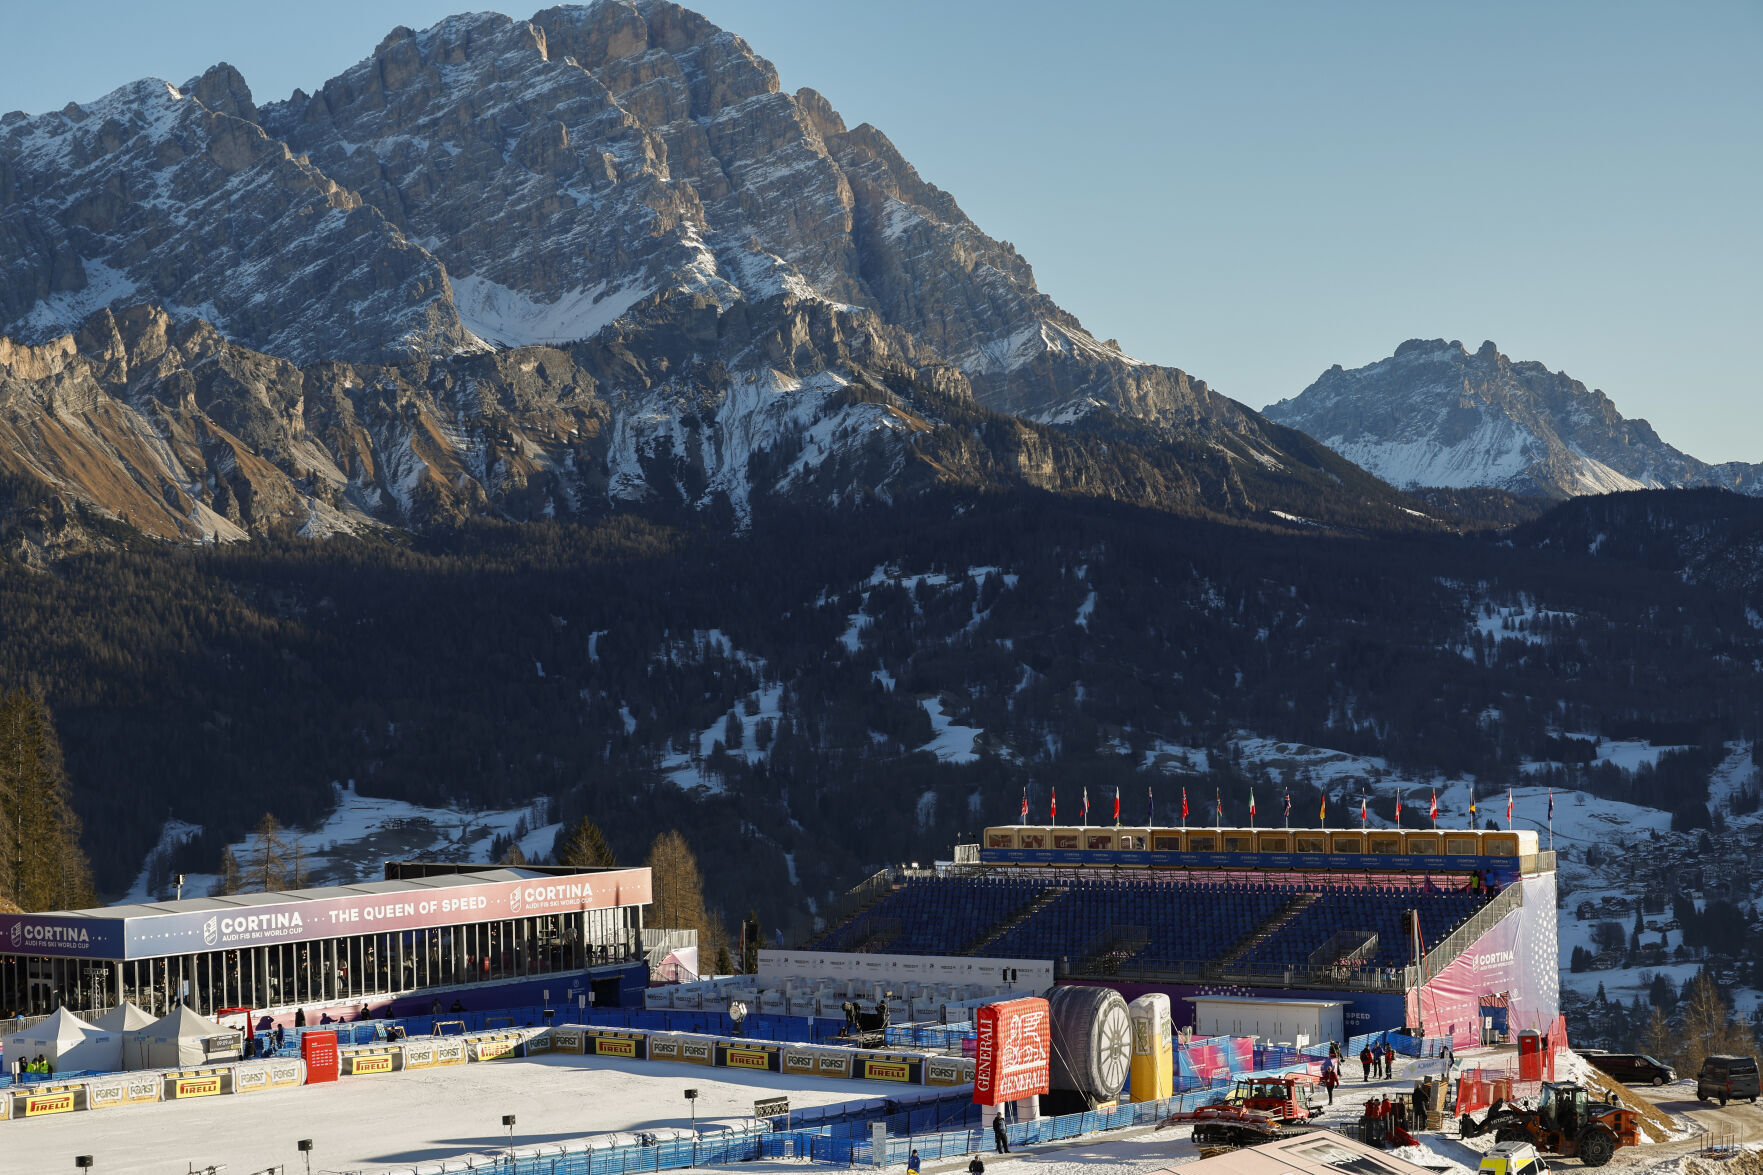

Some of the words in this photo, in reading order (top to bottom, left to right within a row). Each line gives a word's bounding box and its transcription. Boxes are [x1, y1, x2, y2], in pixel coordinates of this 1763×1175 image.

[525, 882, 593, 902] CORTINA
[329, 909, 360, 923] THE
[364, 902, 414, 921] QUEEN
[419, 900, 438, 914] OF
[442, 896, 487, 913] SPEED
[221, 911, 303, 933] CORTINA
[24, 925, 89, 942] CORTINA
[222, 933, 239, 942] AUDI
[240, 932, 251, 940] FIS
[252, 931, 262, 939] SKI
[264, 929, 288, 938] WORLD
[289, 927, 303, 935] CUP
[1480, 950, 1514, 966] CORTINA
[1345, 1012, 1371, 1020] SPEED
[599, 1041, 632, 1054] PIRELLI
[654, 1042, 677, 1053] FORST
[685, 1045, 706, 1057] FORST
[730, 1052, 765, 1066] PIRELLI
[788, 1055, 812, 1067] FORST
[977, 1019, 993, 1092] GENERALI
[356, 1058, 389, 1071] PIRELLI
[821, 1058, 845, 1069] FORST
[868, 1064, 905, 1078] PIRELLI
[931, 1067, 954, 1078] FORST
[180, 1080, 217, 1095] PIRELLI
[1000, 1069, 1046, 1095] GENERALI
[30, 1096, 71, 1113] PIRELLI
